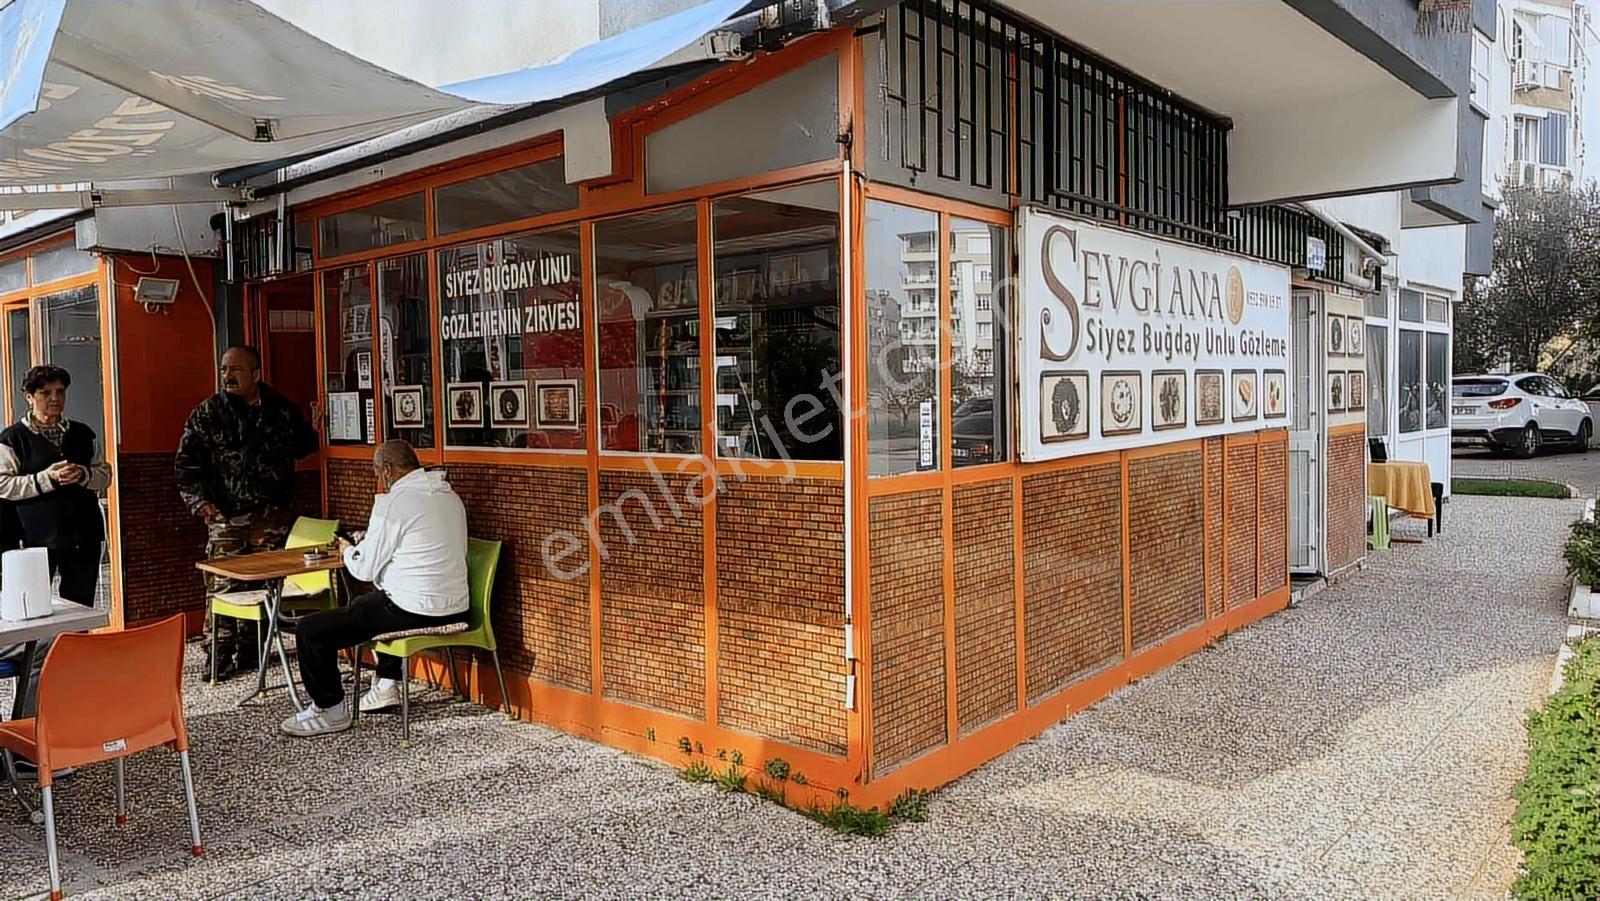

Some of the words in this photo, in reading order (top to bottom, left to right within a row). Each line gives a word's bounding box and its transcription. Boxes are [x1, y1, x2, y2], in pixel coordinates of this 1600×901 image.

[446, 265, 481, 298] SİYEZ
[483, 259, 536, 294] BUĞDAY
[540, 254, 571, 286] UNU
[1168, 266, 1225, 320] ANA
[441, 302, 521, 340] GÖZLEMENİN
[525, 293, 580, 333] ZİRVESİ
[1086, 318, 1136, 362] Siyez
[1143, 322, 1200, 361] Buğday
[1205, 326, 1236, 354] Unlu
[1240, 329, 1287, 358] Gözleme
